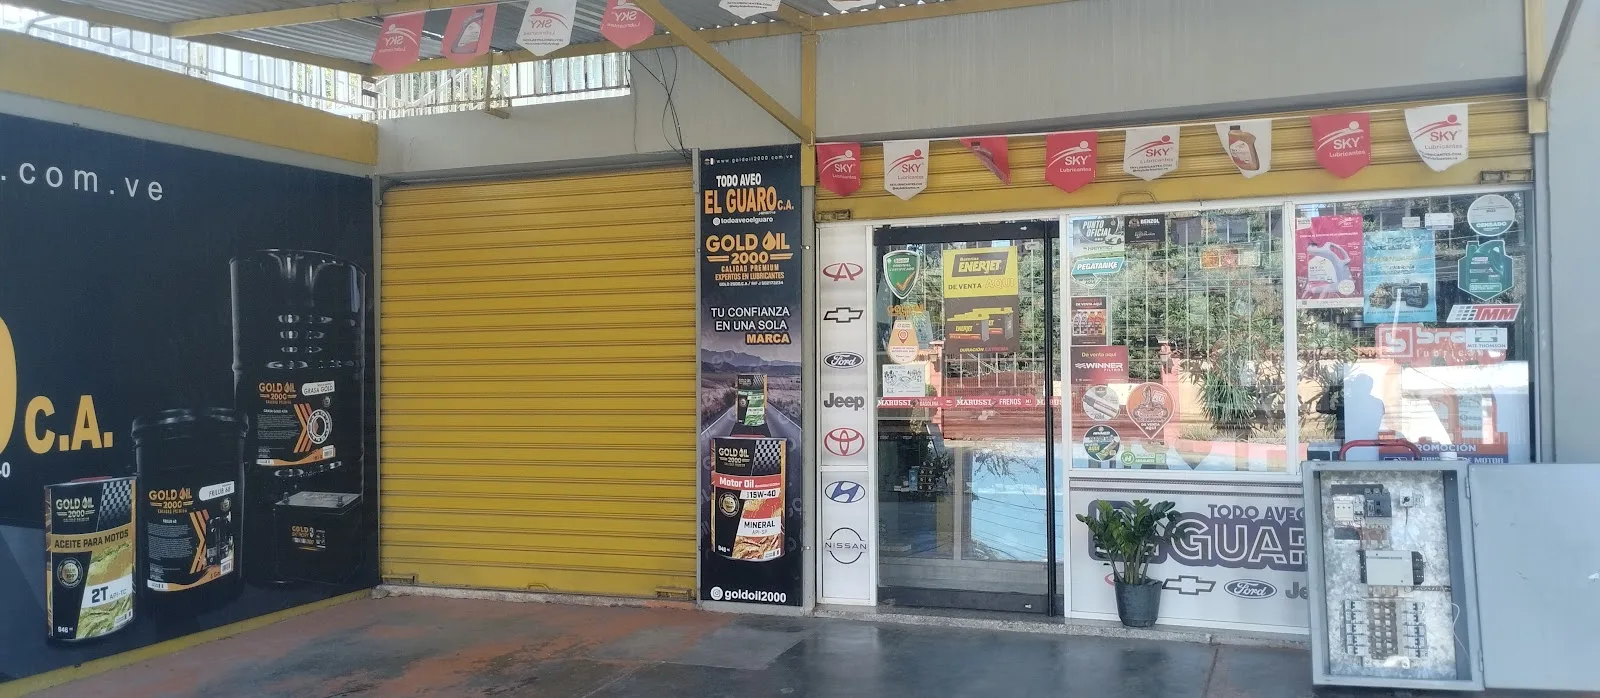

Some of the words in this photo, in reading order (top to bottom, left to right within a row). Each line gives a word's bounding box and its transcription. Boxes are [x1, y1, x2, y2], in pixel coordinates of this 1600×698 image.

[1430, 131, 1458, 142] SKY
[1333, 137, 1361, 150] SKY
[1145, 148, 1170, 158] SKY
[1329, 150, 1366, 158] Lubricantes
[1064, 156, 1089, 166] SKY
[834, 163, 854, 173] SKY
[902, 163, 922, 173] SKY
[716, 174, 738, 187] TODO
[740, 173, 762, 186] AVEO
[704, 190, 722, 214] EL
[726, 186, 777, 213] GUARO
[777, 200, 794, 210] C.A.
[1083, 220, 1105, 230] PUNTO
[1087, 228, 1111, 237] OFICIAL
[706, 233, 759, 252] GOLD
[762, 231, 790, 250] OIL
[731, 251, 769, 264] 2000
[958, 260, 1002, 273] ENERJET
[1077, 262, 1118, 270] PEGATANKE
[711, 308, 725, 317] TU
[728, 307, 790, 316] CONFIANZA
[1473, 304, 1519, 321] TMM
[716, 321, 730, 330] EN
[734, 321, 756, 330] UNA
[758, 320, 787, 330] SOLA
[747, 334, 790, 343] MARCA
[831, 355, 856, 366] Ford
[259, 383, 282, 392] GOLD
[284, 382, 296, 392] OIL
[824, 393, 864, 411] Jeep
[877, 399, 911, 407] MARUSSI
[956, 398, 991, 407] MARUSSI
[25, 394, 114, 455] C.A.
[719, 448, 738, 456] GOLD
[739, 448, 749, 457] OIL
[1415, 444, 1476, 452] ROMOCIÓN
[720, 477, 742, 487] Motor
[149, 489, 178, 500] GOLD
[180, 488, 193, 500] OIL
[750, 490, 776, 498] 15W-40
[56, 498, 80, 510] GOLD
[82, 496, 94, 509] OIL
[163, 501, 182, 509] 2000
[68, 510, 85, 518] 2000
[1208, 504, 1259, 521] TODO
[55, 540, 81, 548] ACEITE
[83, 537, 103, 547] PARA
[105, 529, 129, 542] MOTOS
[825, 542, 867, 550] NISSAN
[92, 586, 108, 603] 2T
[1234, 583, 1267, 597] Ford
[725, 590, 787, 602] goldoil2000
